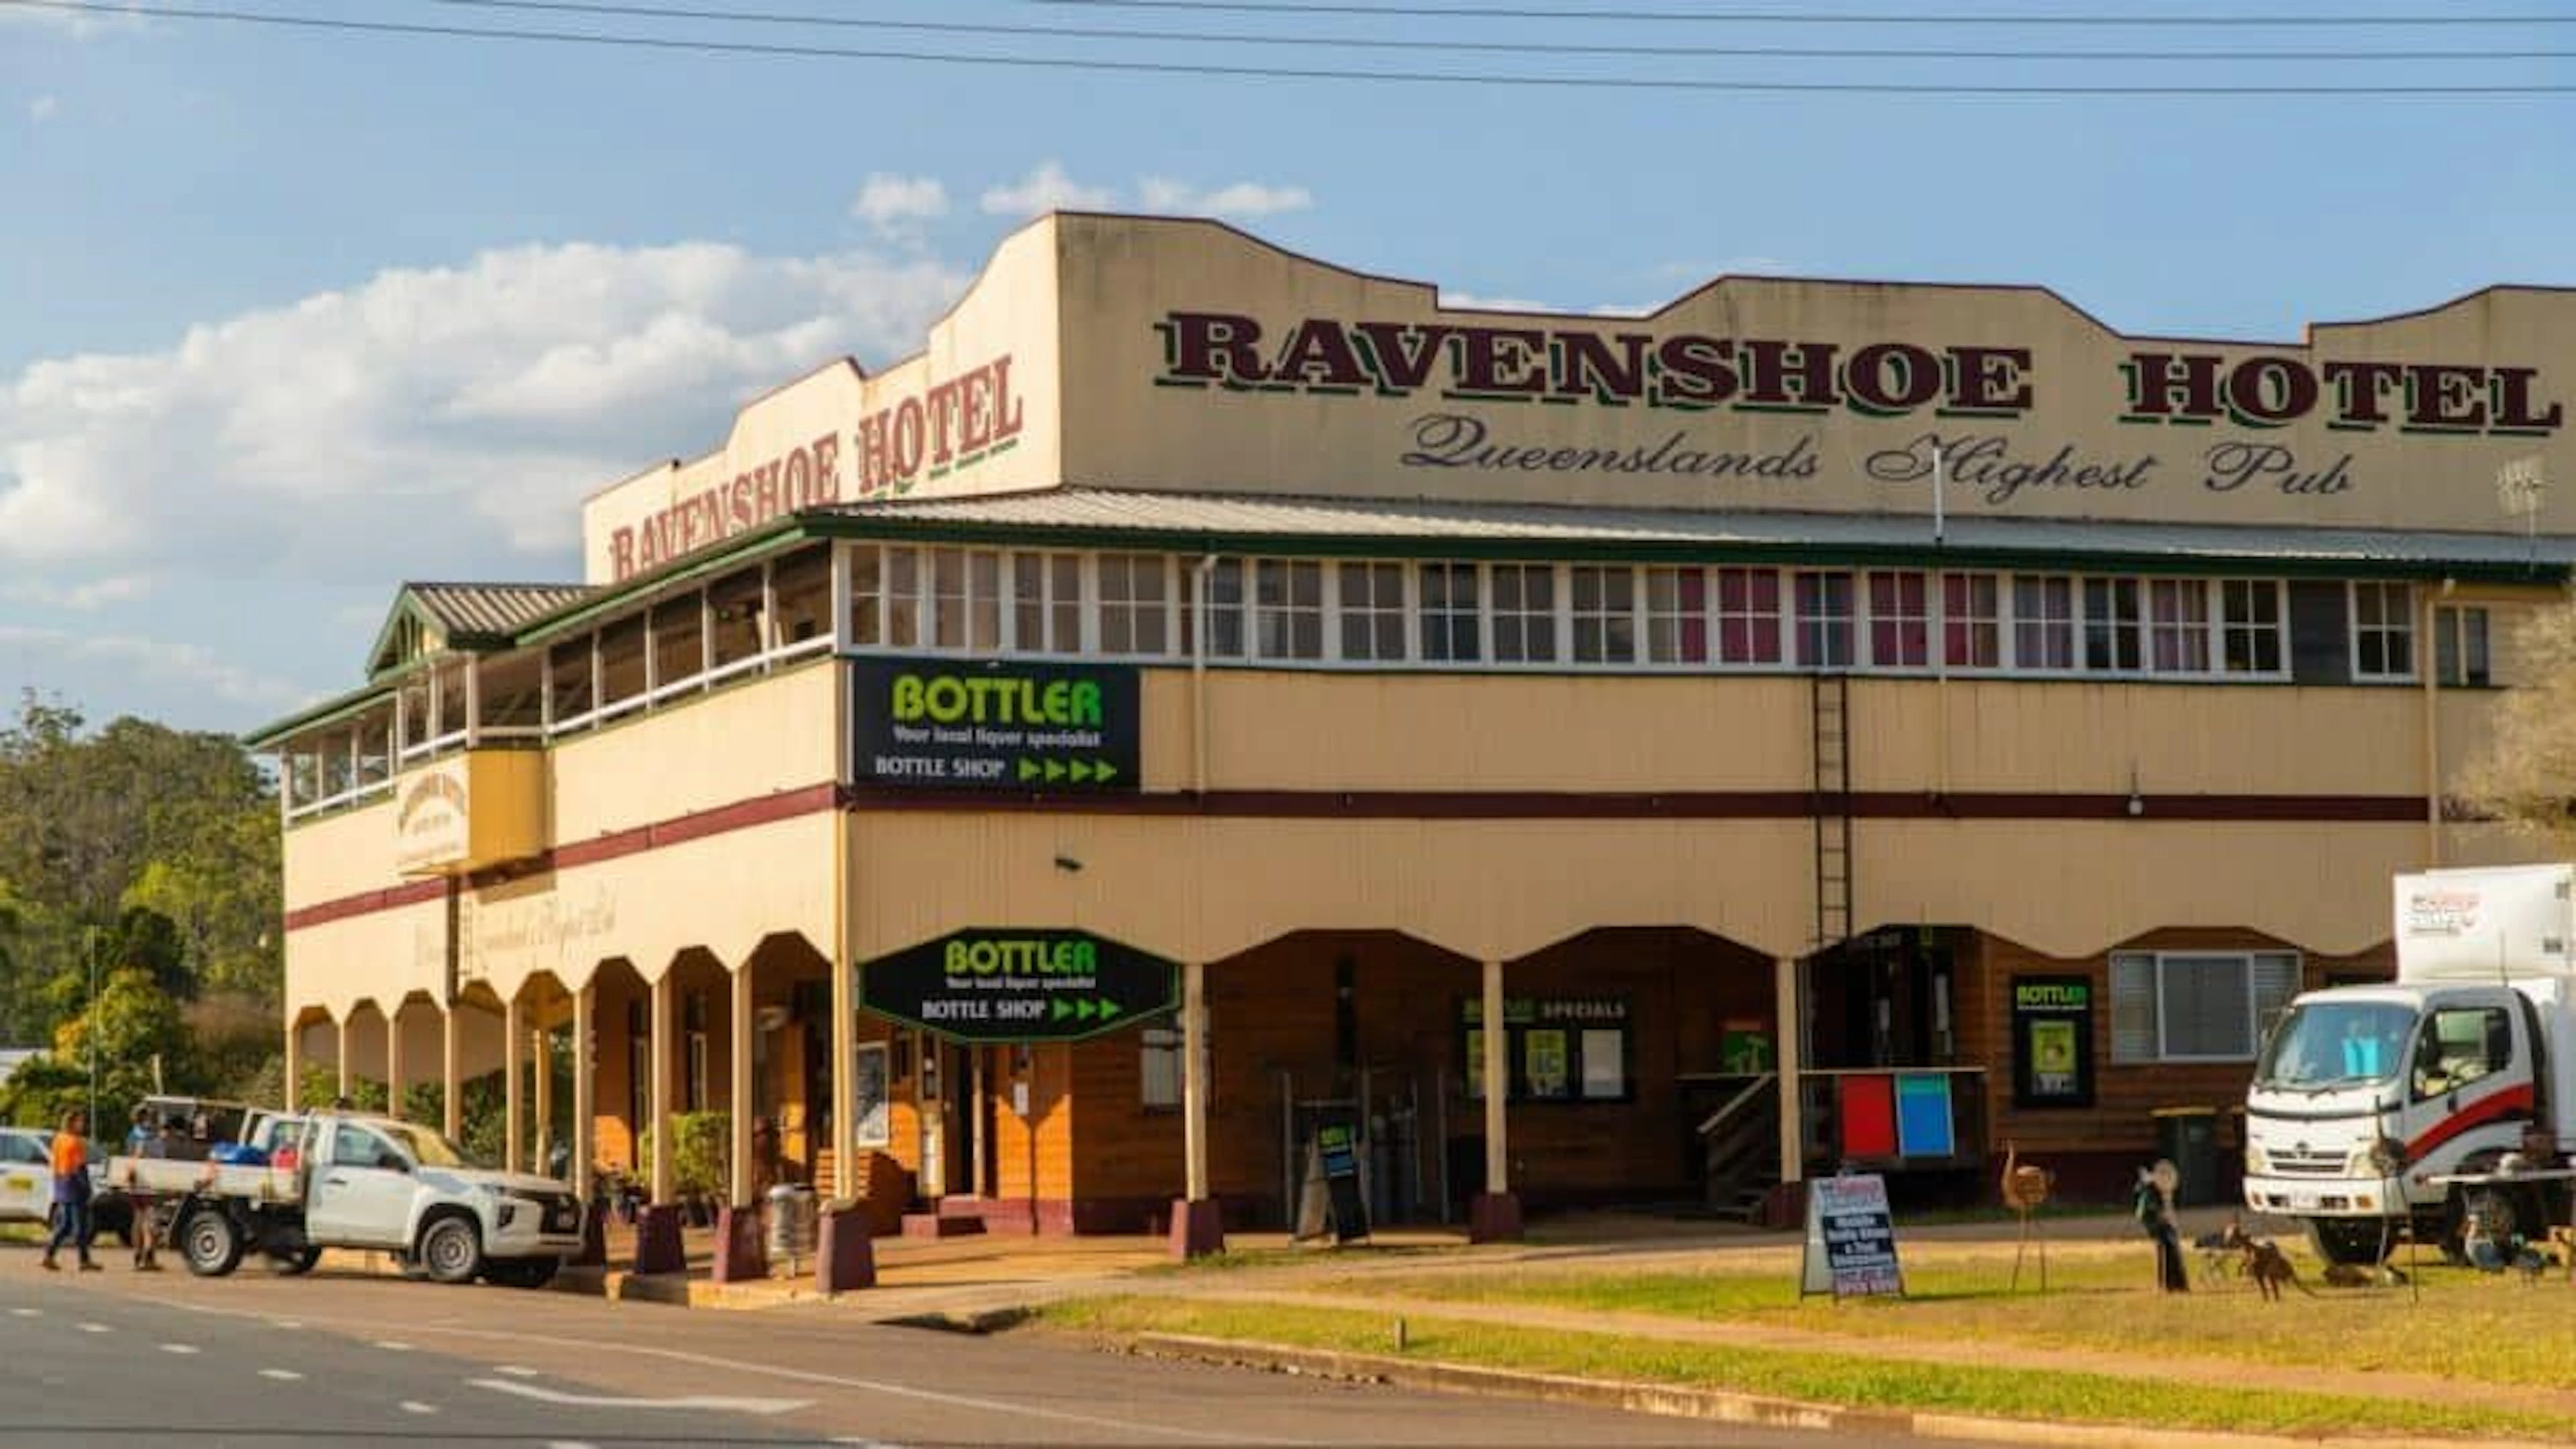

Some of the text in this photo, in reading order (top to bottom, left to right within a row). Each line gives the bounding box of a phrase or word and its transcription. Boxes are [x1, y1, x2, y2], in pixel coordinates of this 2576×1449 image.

[1155, 311, 2561, 437] RAVENSHOE HOTEL
[609, 354, 1022, 581] RAVENSHOE HOTEL
[1401, 411, 2353, 503] Queenslands Highest Pub
[892, 674, 1102, 724] BOTTLER
[892, 726, 1102, 749] Your local liquor specialist
[875, 756, 1006, 778] BOTTLE SHOP
[945, 941, 1097, 973] BOTTLER
[922, 1000, 1046, 1019] BOTTLE SHOP
[1544, 1002, 1626, 1019] SPECIALS
